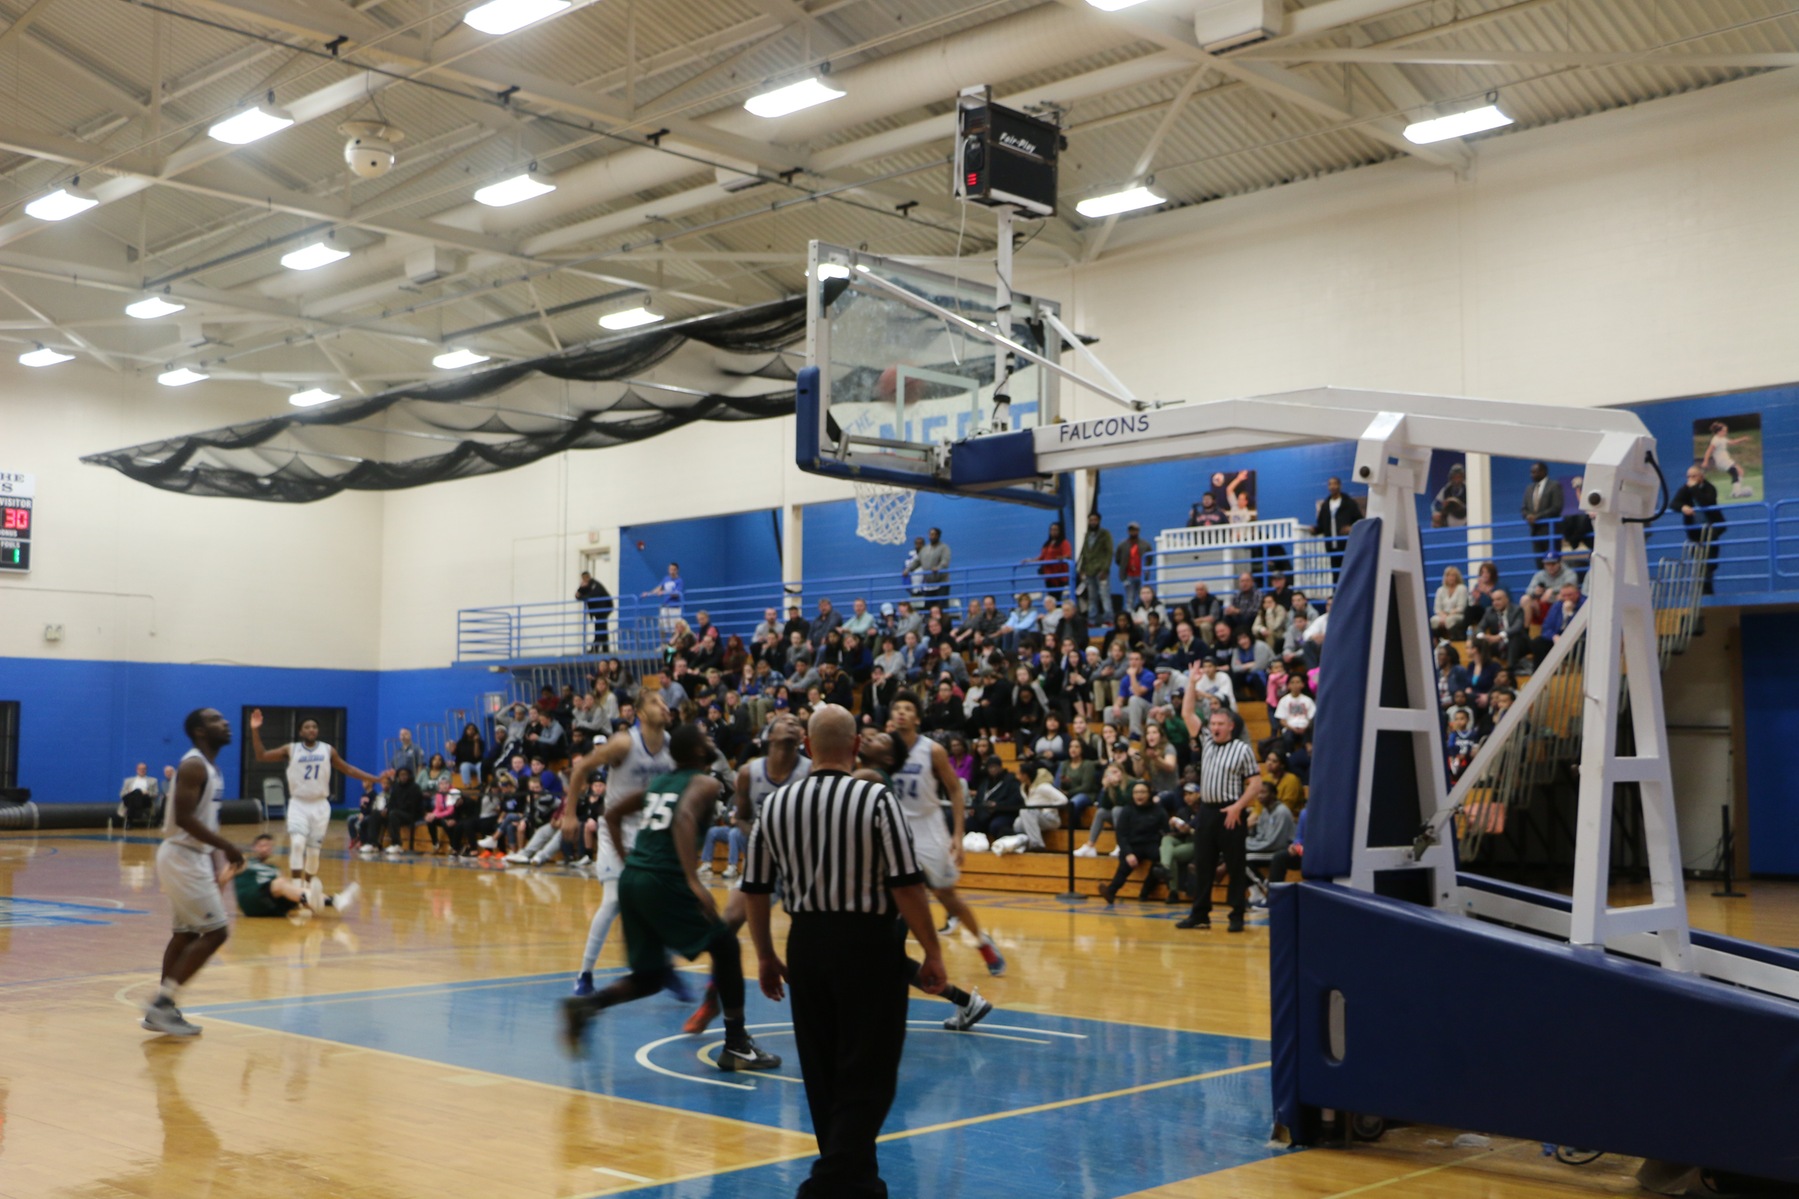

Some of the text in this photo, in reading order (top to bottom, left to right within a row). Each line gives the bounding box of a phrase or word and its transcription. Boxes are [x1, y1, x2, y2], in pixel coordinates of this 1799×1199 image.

[999, 132, 1036, 154] Fair-Play
[1060, 415, 1149, 443] FALCONS
[0, 498, 32, 509] VISITOR
[4, 508, 29, 529] 30
[0, 529, 18, 538] ONUS
[14, 548, 20, 564] 1
[304, 764, 320, 780] 21
